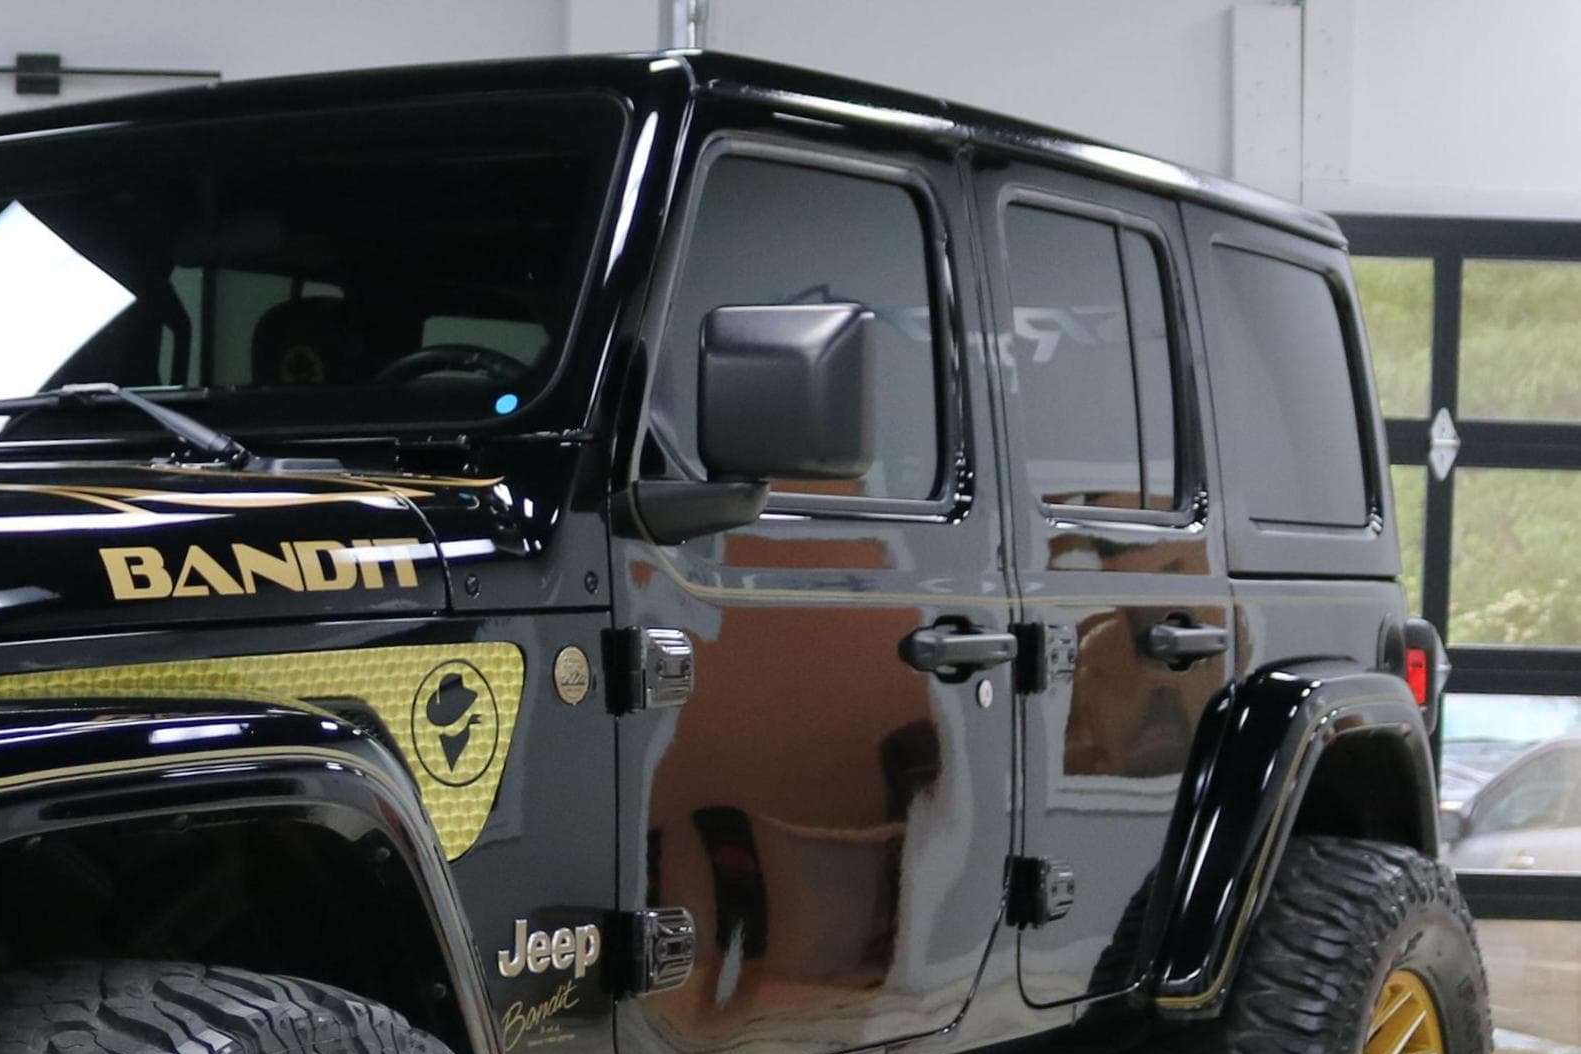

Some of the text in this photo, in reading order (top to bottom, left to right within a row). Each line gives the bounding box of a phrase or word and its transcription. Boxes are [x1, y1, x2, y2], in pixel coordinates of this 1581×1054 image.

[98, 538, 419, 601] BANDIT
[498, 919, 601, 979] Jeep
[502, 980, 580, 1051] Bandit
